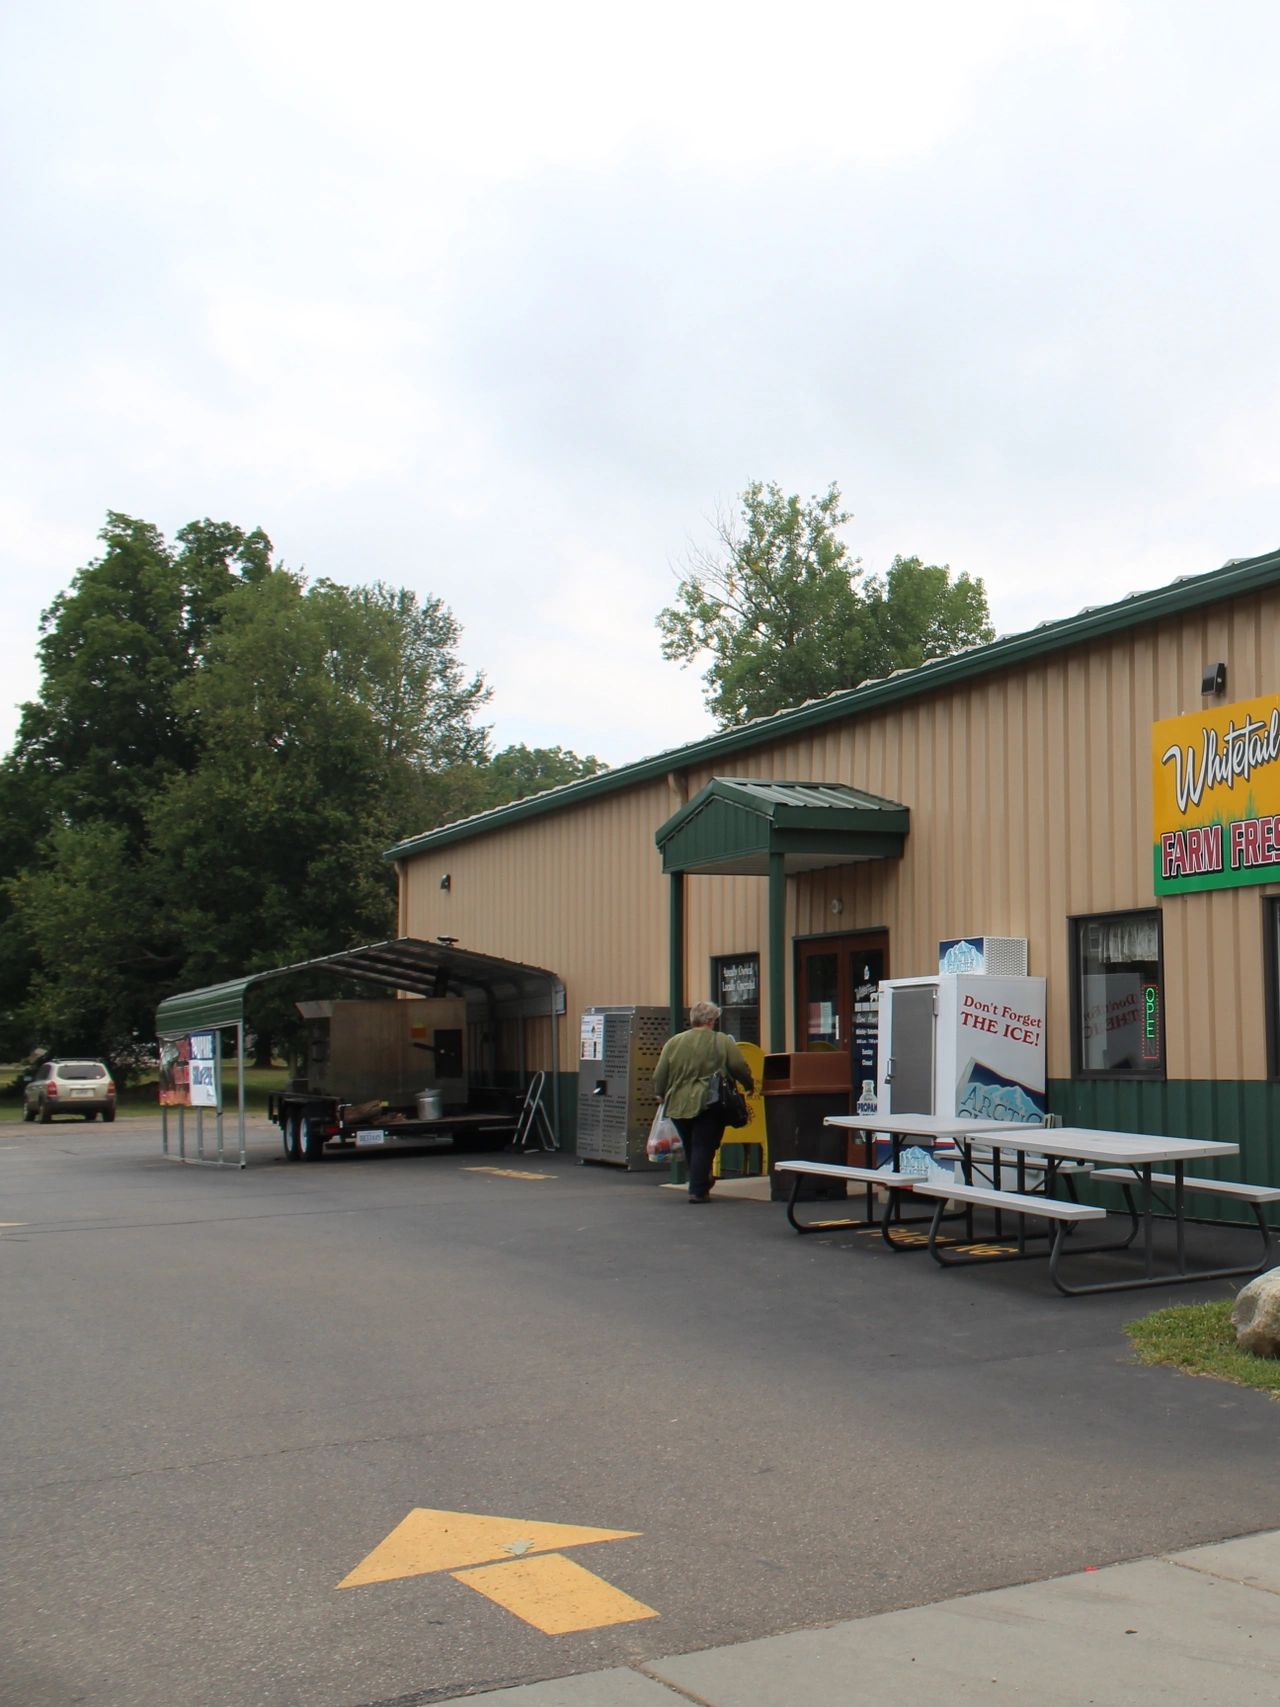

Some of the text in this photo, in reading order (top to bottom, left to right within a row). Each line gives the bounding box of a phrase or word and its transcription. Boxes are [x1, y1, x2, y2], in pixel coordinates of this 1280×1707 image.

[1161, 825, 1223, 878] FARM
[960, 1010, 1041, 1048] THE ICE!
[963, 994, 1043, 1029] Don't Forget
[857, 1102, 878, 1113] PROPAN
